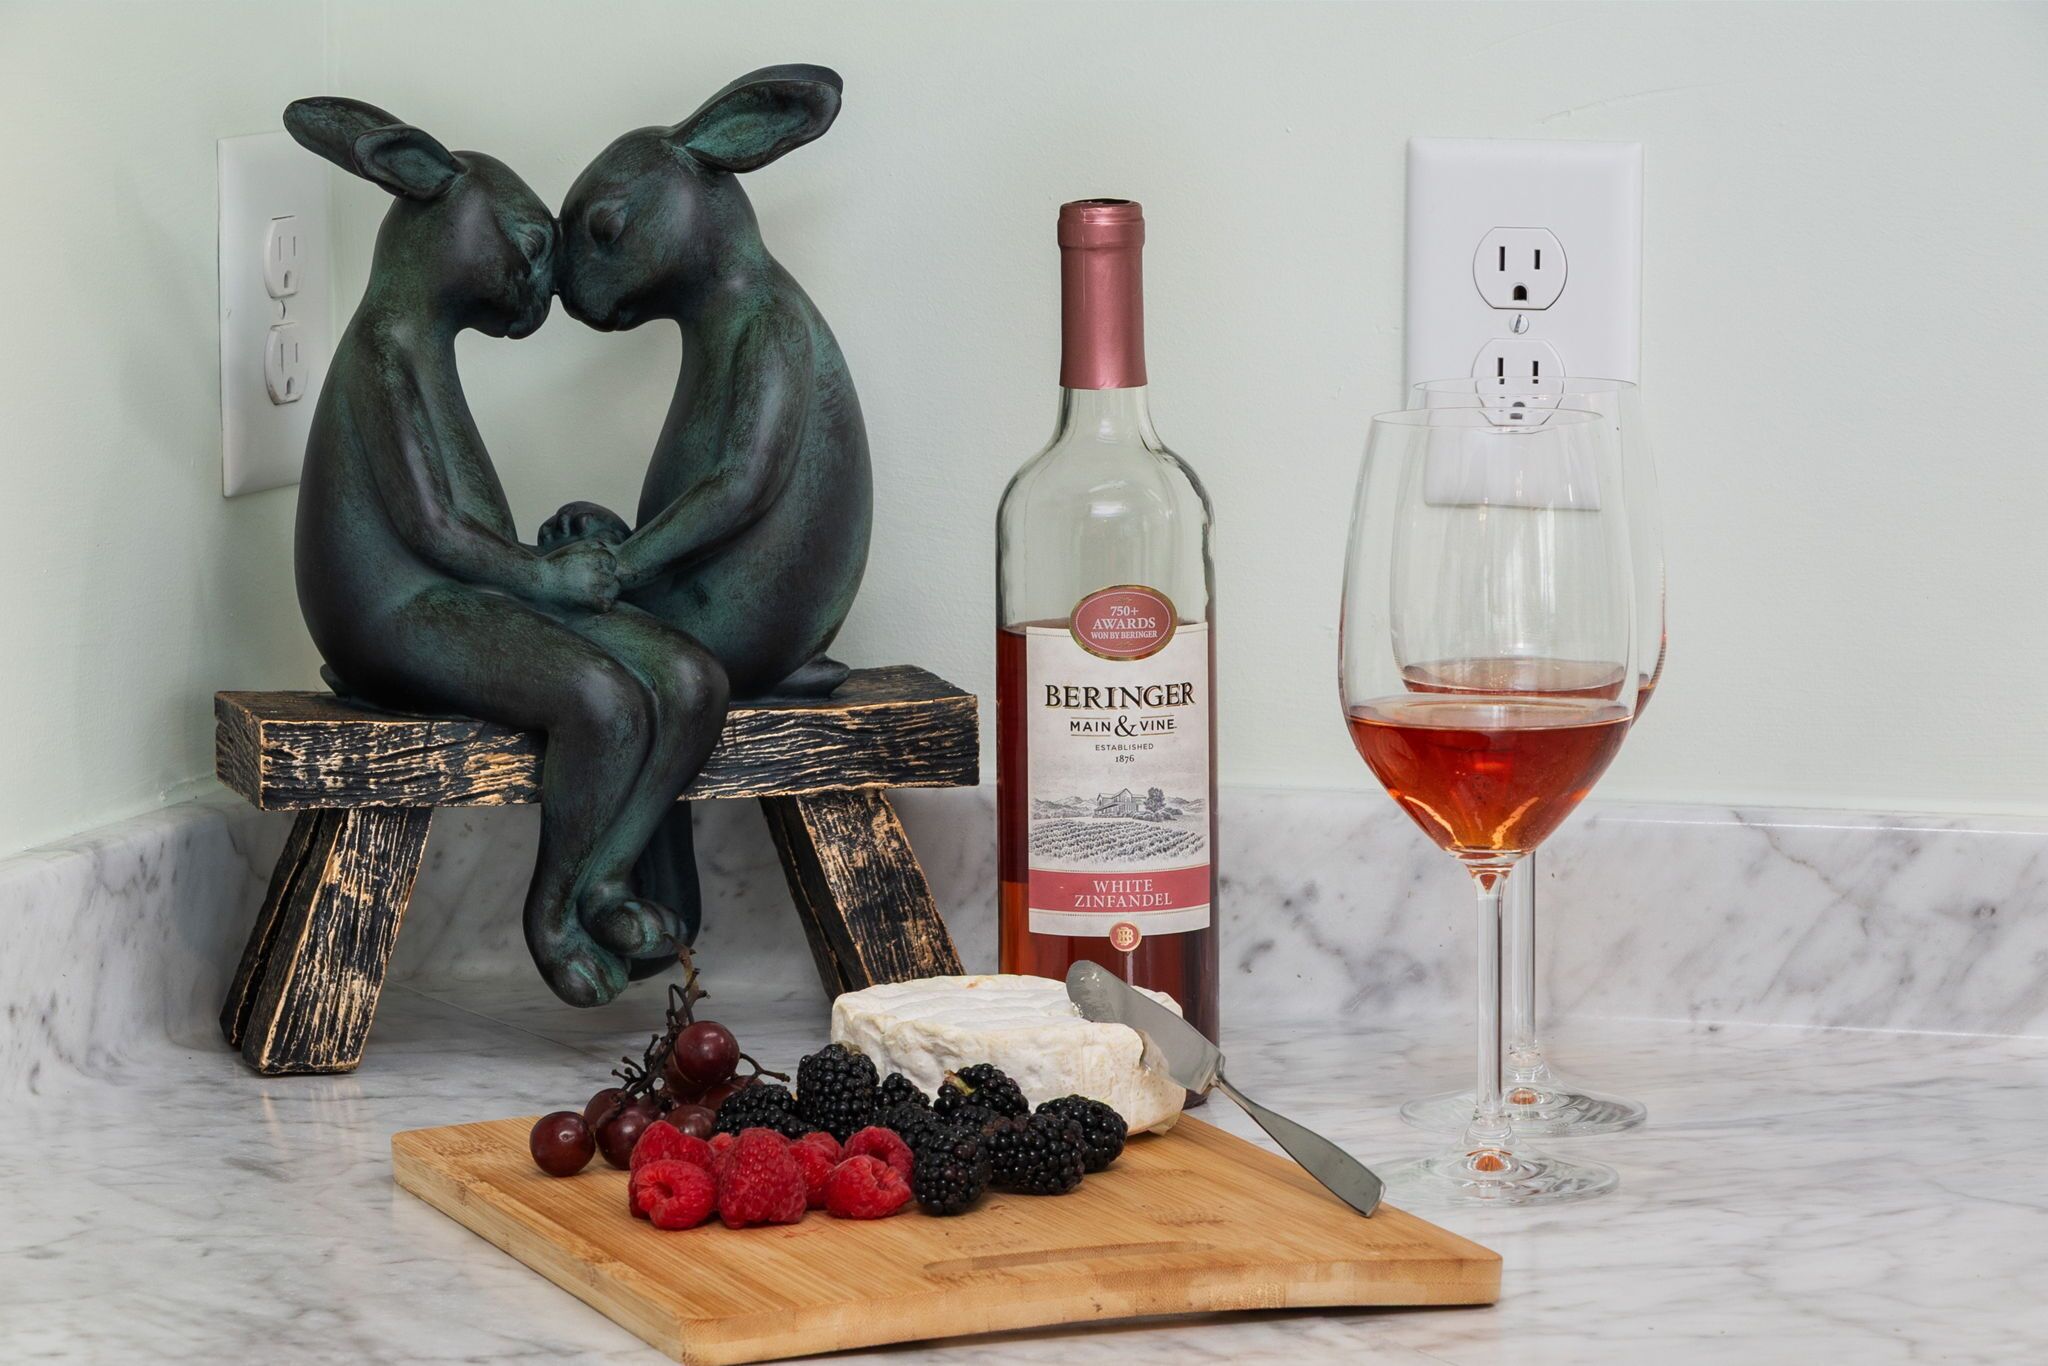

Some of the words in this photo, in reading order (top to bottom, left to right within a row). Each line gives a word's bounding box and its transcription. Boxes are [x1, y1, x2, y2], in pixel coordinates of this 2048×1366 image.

[1110, 606, 1139, 617] 750+
[1092, 617, 1156, 630] AWARDS
[1090, 631, 1109, 640] WON
[1110, 630, 1120, 640] BY
[1120, 630, 1158, 639] BERINGER
[1045, 682, 1196, 710] BERINGER
[1070, 720, 1111, 732] MAIN
[1114, 715, 1138, 737] &
[1140, 718, 1176, 731] VINE
[1095, 743, 1154, 751] ESTABLISHED
[1115, 754, 1135, 764] 1876
[1093, 879, 1153, 893] WHITE
[1074, 893, 1172, 908] ZINFANDEL
